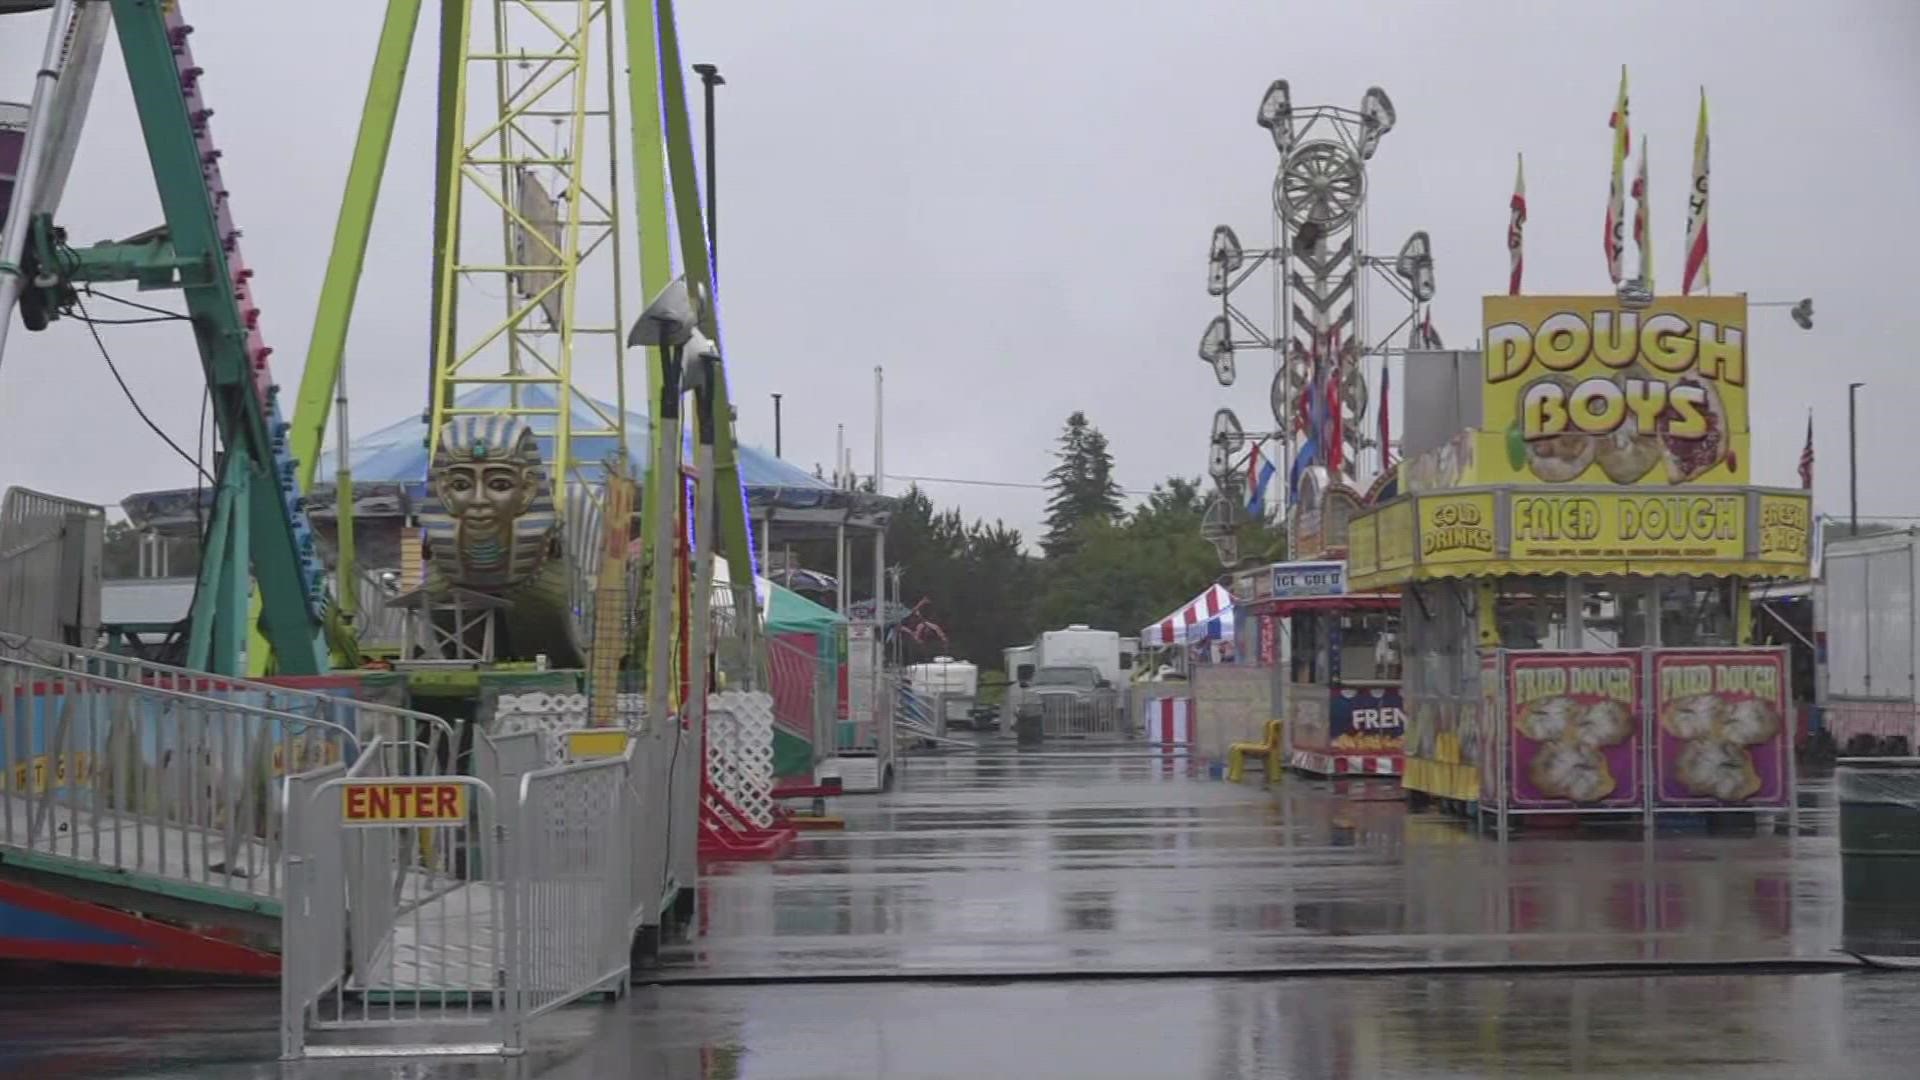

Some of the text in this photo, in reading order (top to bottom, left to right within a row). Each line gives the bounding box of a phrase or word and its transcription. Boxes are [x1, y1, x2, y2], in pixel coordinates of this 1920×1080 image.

[1486, 310, 1745, 387] DOUGH
[1522, 377, 1709, 442] BOYS
[1432, 503, 1481, 528] COLD
[1514, 497, 1738, 541] FRIED DOUGH
[1424, 527, 1493, 554] DRINKS
[1514, 666, 1632, 704] FRIED DOUGH
[1661, 665, 1777, 703] FRIED DOUGH
[346, 786, 459, 819] ENTER
